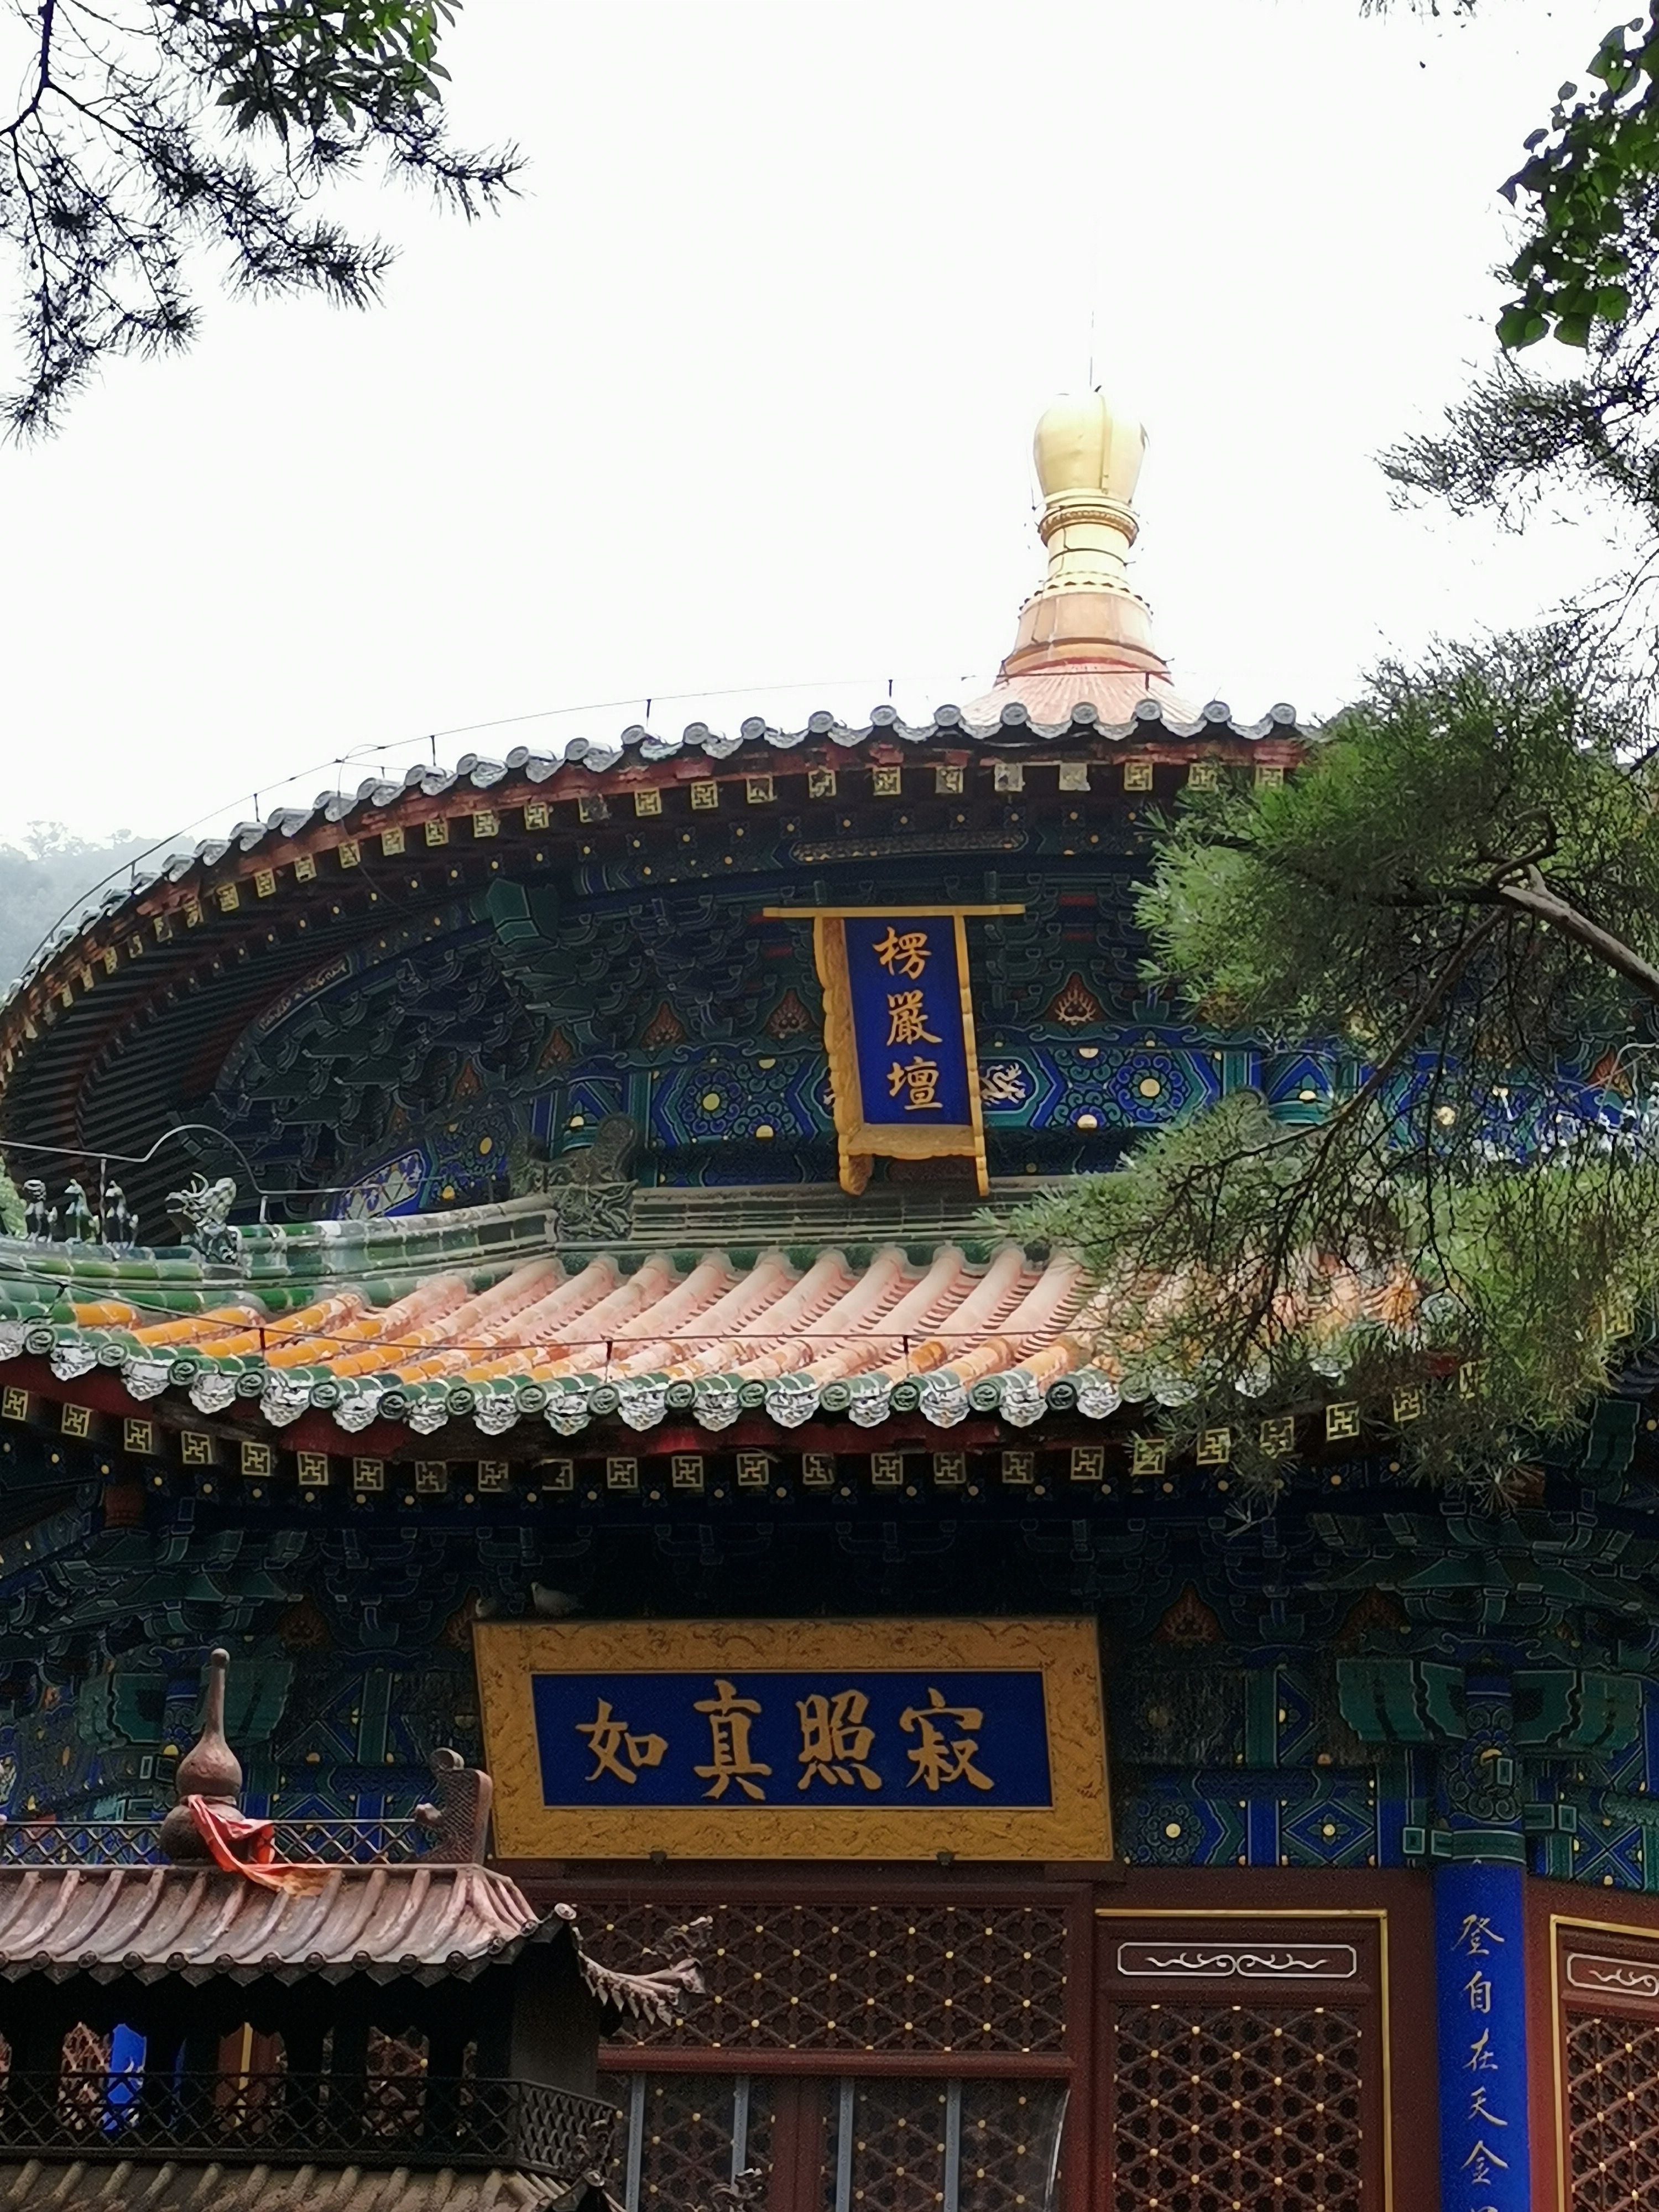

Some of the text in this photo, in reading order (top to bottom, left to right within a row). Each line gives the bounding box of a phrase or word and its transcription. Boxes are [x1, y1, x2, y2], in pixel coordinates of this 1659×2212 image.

[1450, 1913, 1509, 2212] 登自在天金
